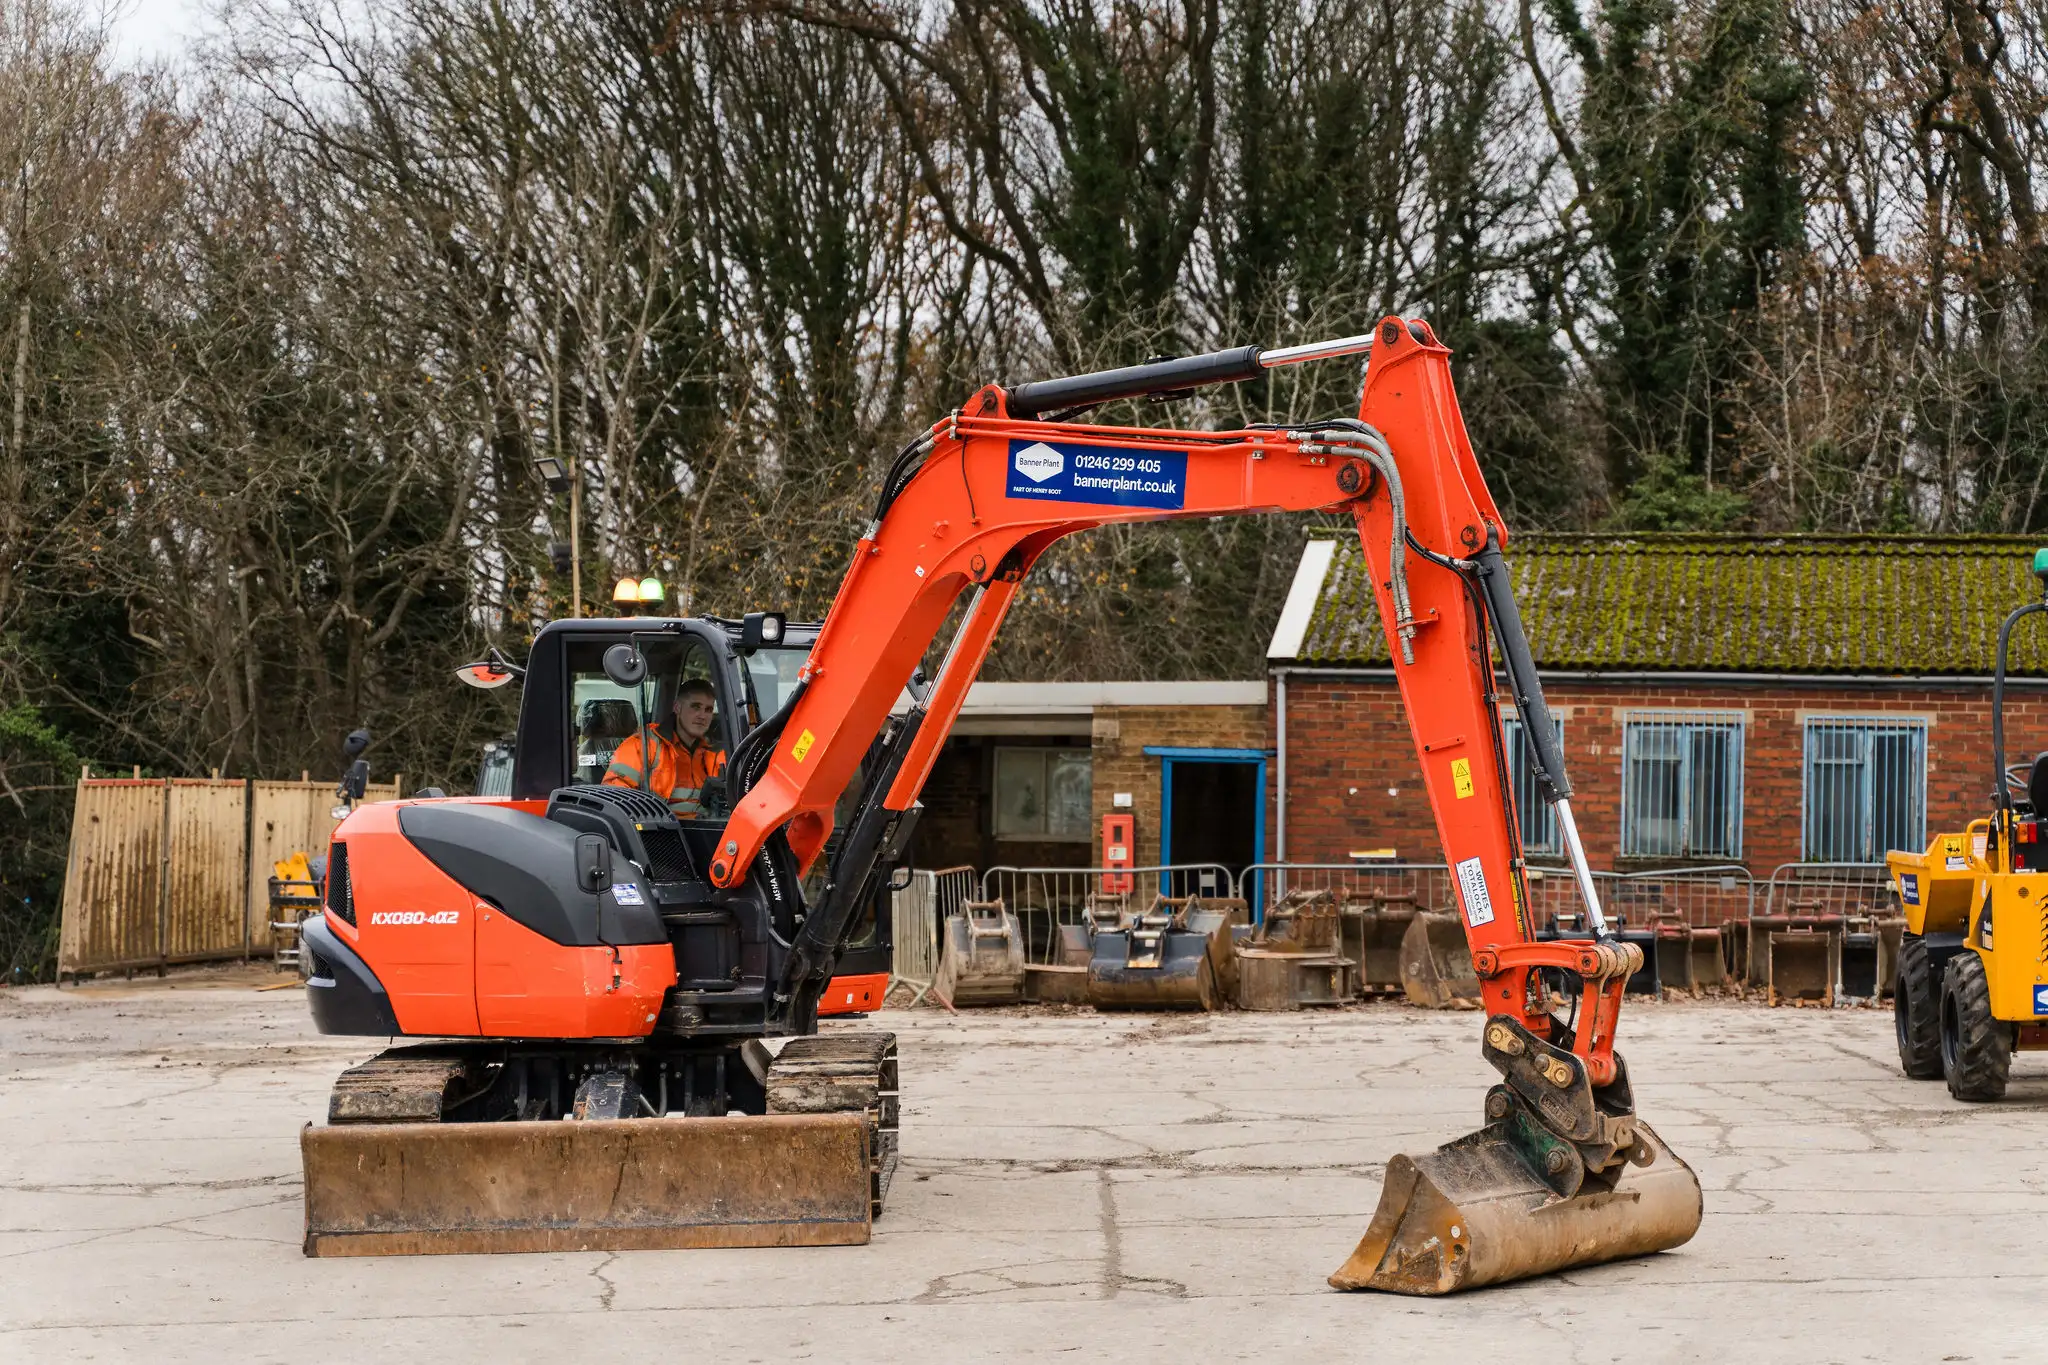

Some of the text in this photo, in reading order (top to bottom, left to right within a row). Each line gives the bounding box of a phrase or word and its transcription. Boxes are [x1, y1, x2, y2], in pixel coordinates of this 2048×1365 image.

[1019, 457, 1060, 468] Banner Plant
[1075, 454, 1161, 473] 01246 299 405
[1073, 472, 1177, 494] bannerplant.co.uk
[770, 877, 781, 901] MSHA
[1467, 863, 1484, 914] TOTALOCK
[1476, 870, 1489, 910] WHITES
